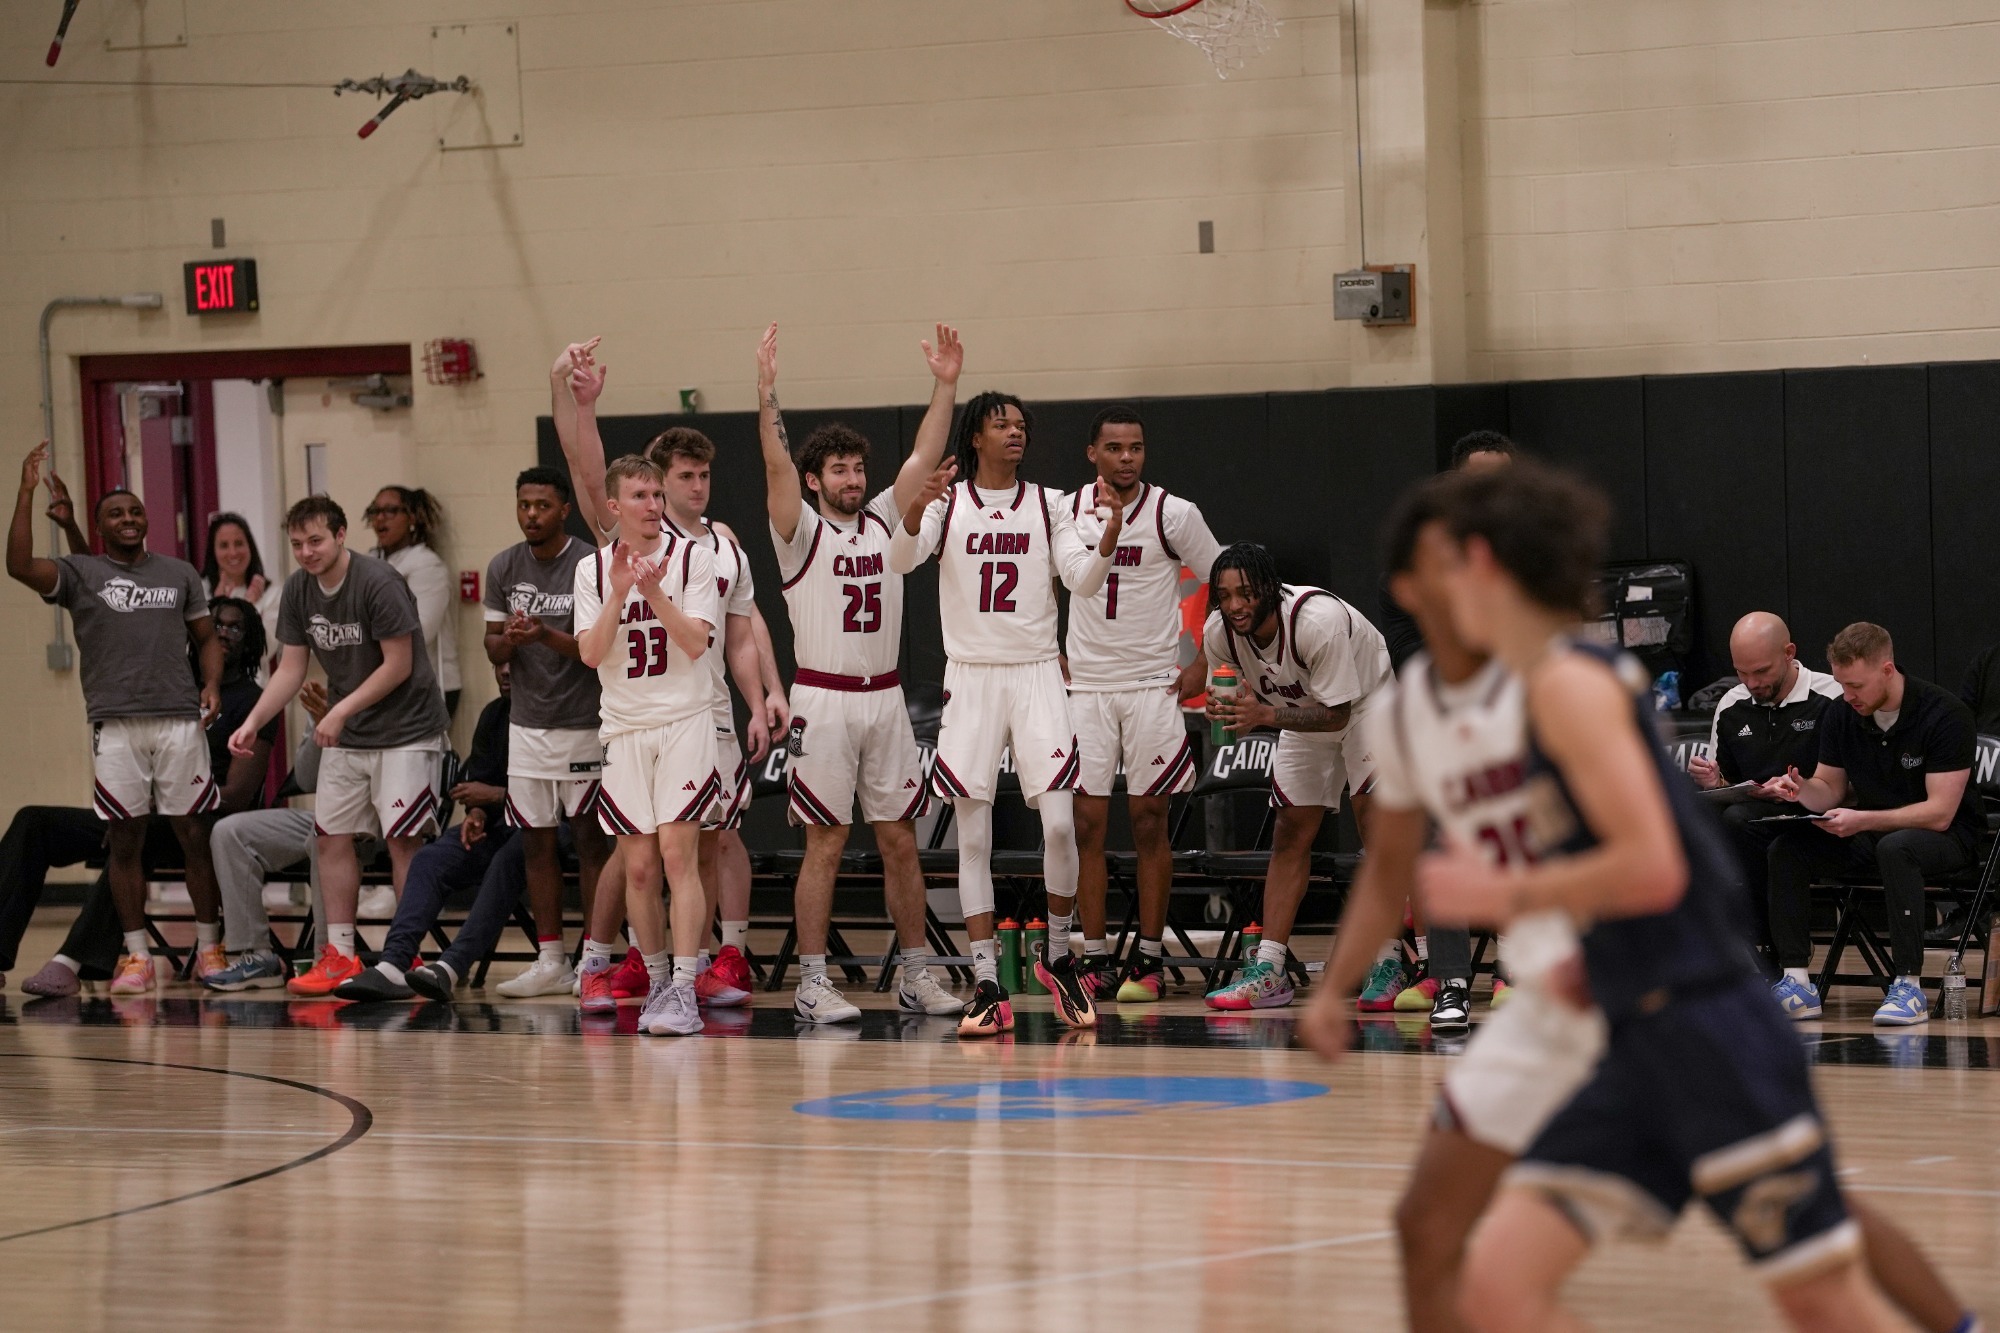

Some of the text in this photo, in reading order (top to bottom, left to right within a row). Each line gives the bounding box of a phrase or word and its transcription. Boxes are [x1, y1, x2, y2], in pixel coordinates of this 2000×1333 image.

[195, 265, 234, 309] EXIT
[833, 552, 884, 577] CAIRN
[966, 533, 1030, 554] CAIRN
[129, 587, 176, 606] CAIRN
[530, 594, 573, 613] CAIRN
[843, 582, 882, 633] 25
[979, 562, 1018, 612] 12
[1106, 573, 1119, 619] 1
[628, 627, 667, 679] 33
